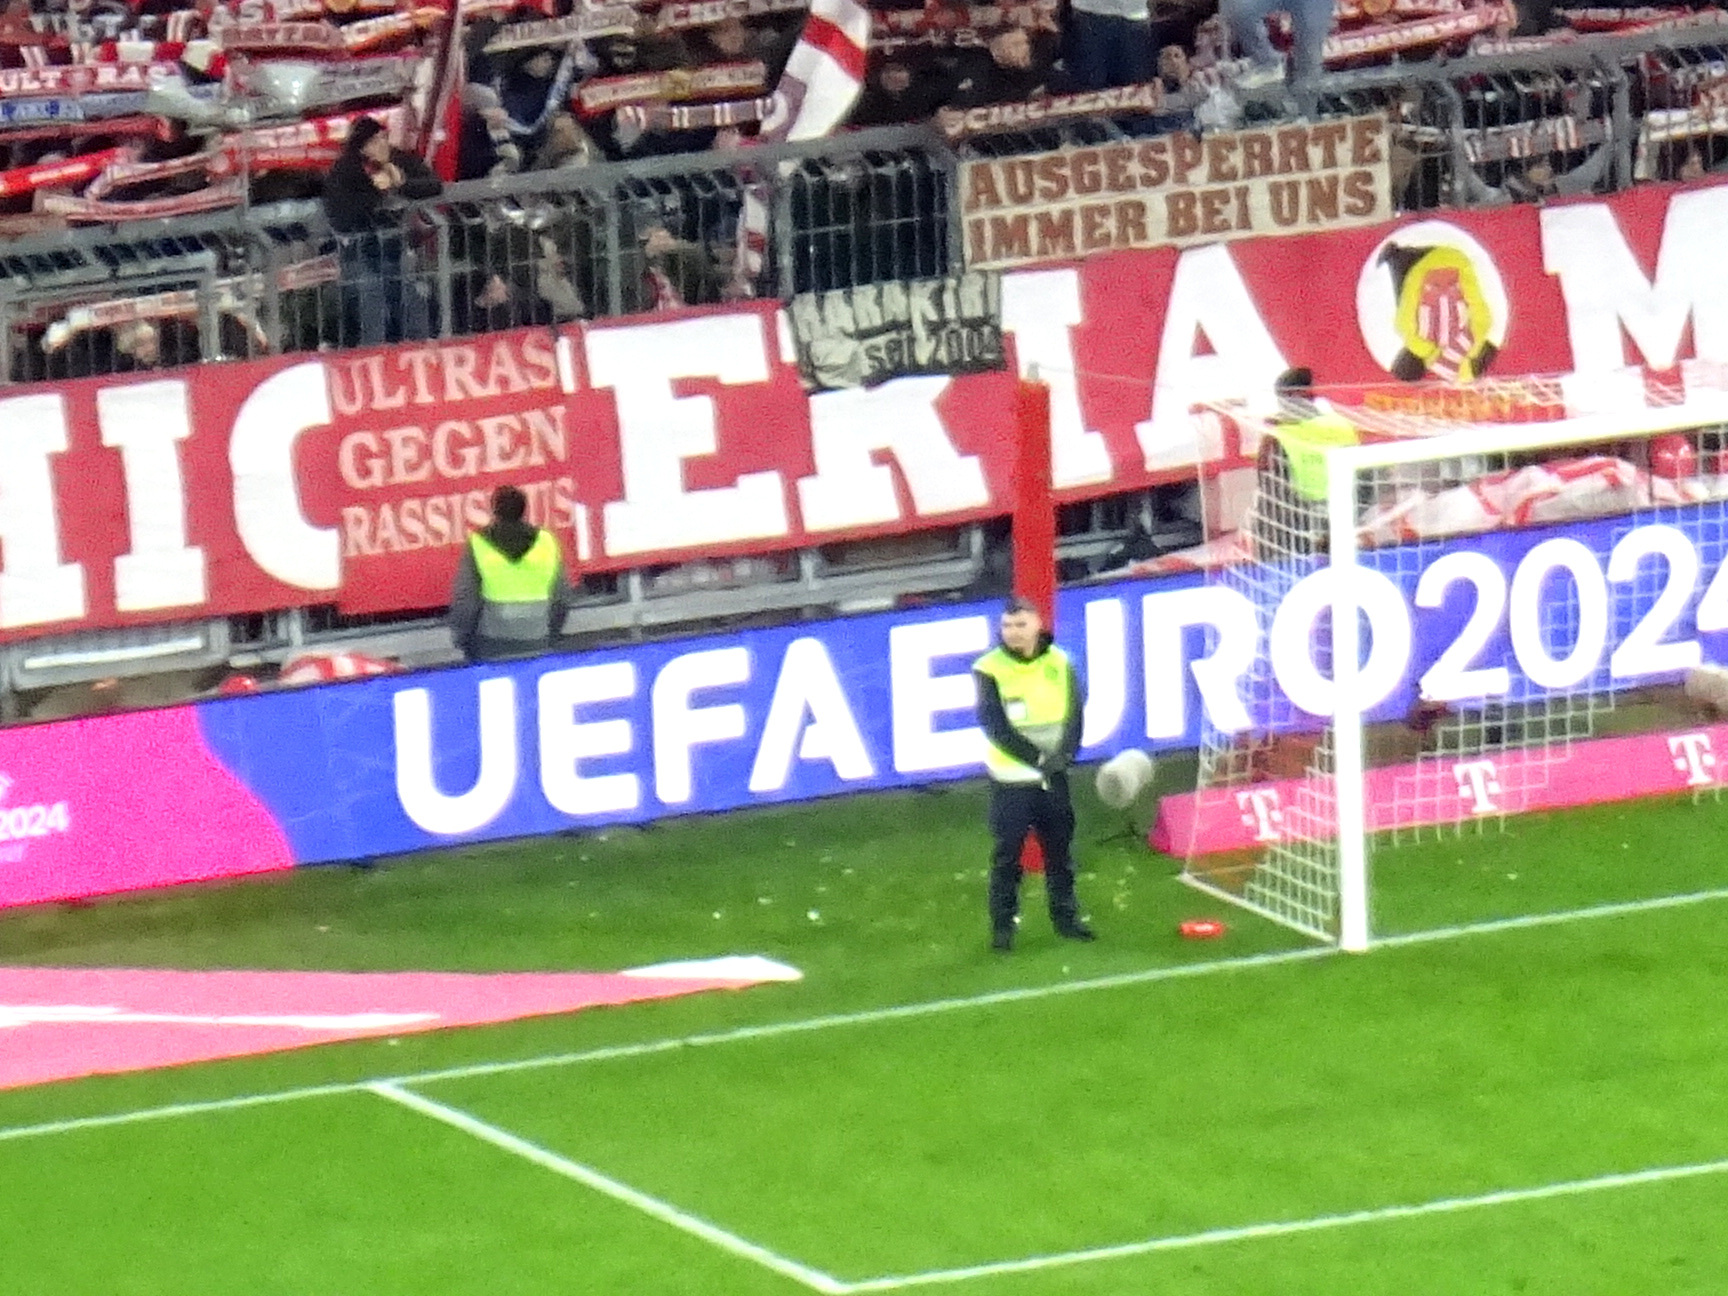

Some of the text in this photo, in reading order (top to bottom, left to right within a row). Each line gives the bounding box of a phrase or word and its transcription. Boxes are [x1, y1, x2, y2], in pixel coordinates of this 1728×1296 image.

[969, 118, 1384, 206] AUSGESPERRTE
[967, 171, 1374, 259] IMMER BEI UNS
[331, 332, 560, 416] ULTRAS
[338, 406, 570, 490] GEGEN
[341, 474, 579, 558] RASSISUS
